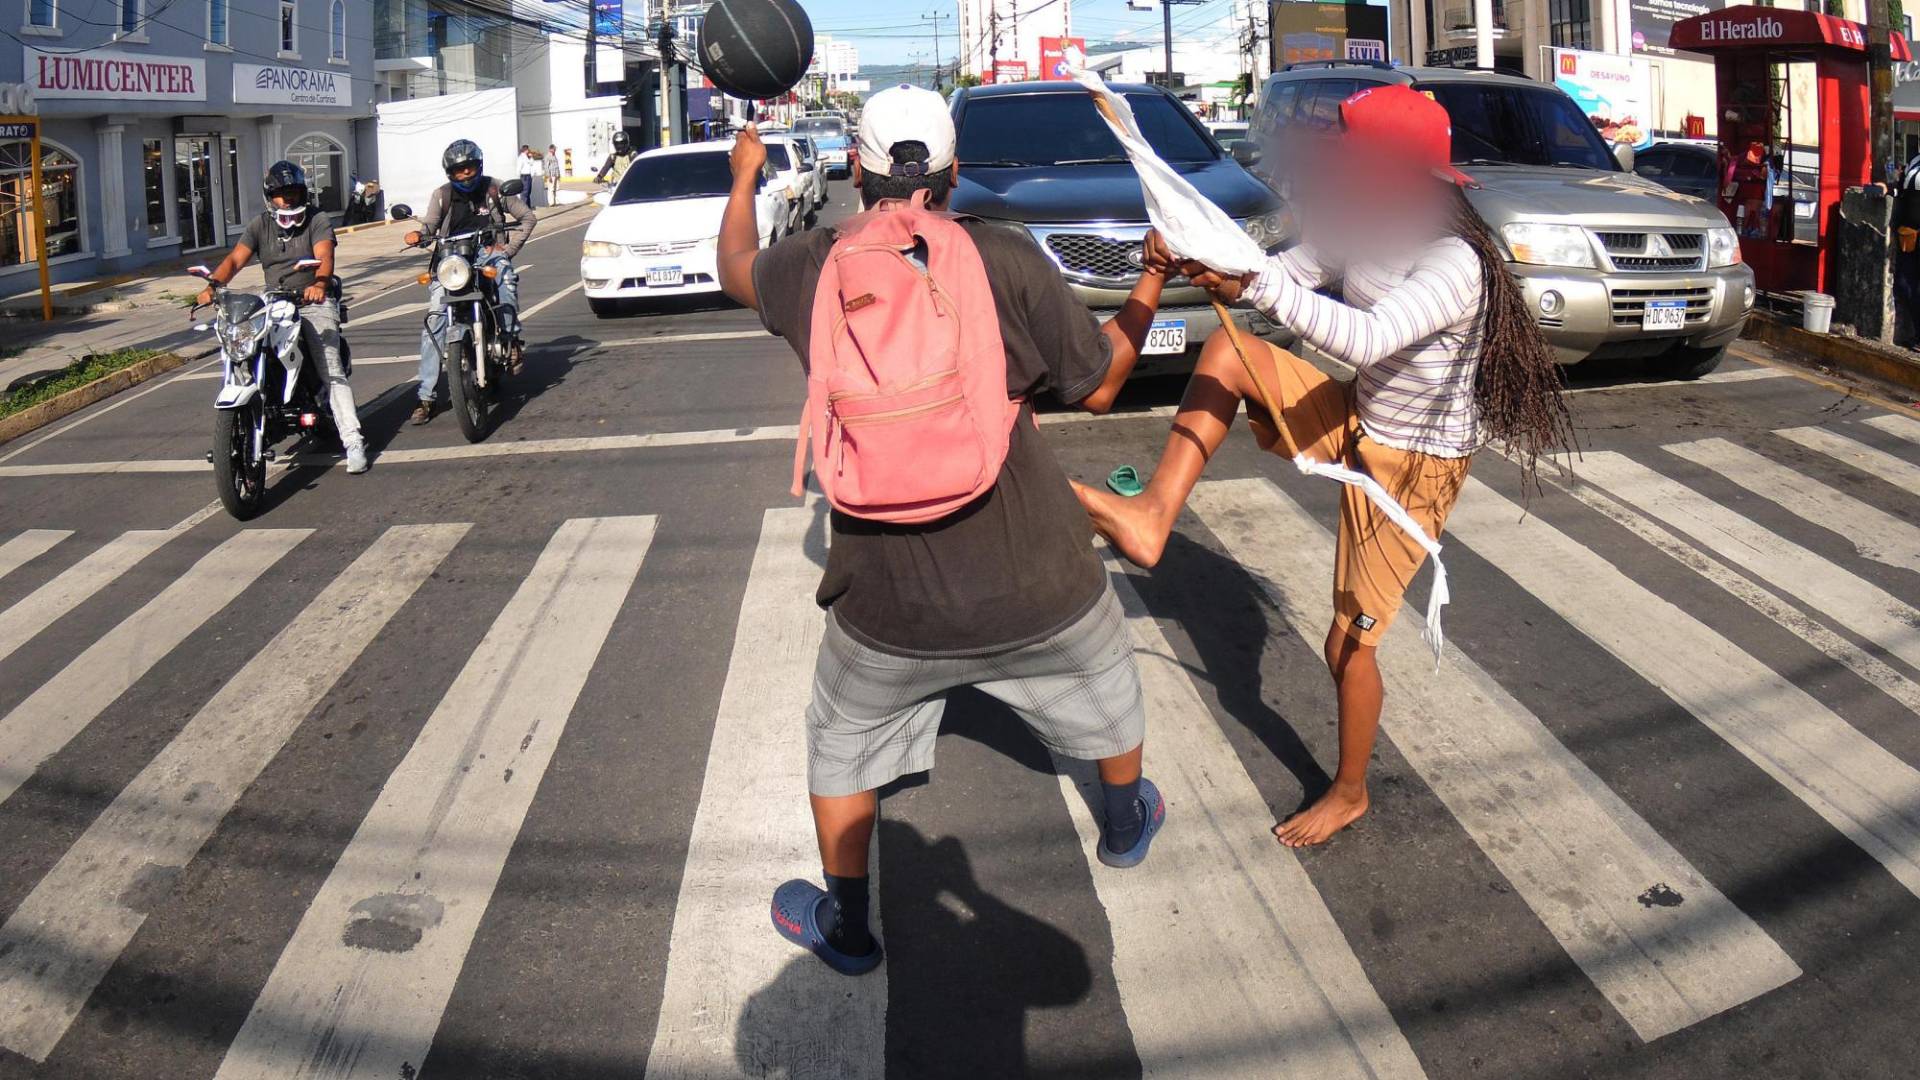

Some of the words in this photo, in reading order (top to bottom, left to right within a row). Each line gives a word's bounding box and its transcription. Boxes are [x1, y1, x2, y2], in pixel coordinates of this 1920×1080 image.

[1701, 21, 1715, 40] El
[1719, 17, 1783, 40] Heraldo
[1349, 47, 1381, 59] ELVIA
[38, 56, 195, 93] LUMICENTER
[266, 68, 335, 92] PANORAMA
[1150, 329, 1183, 347] 8203
